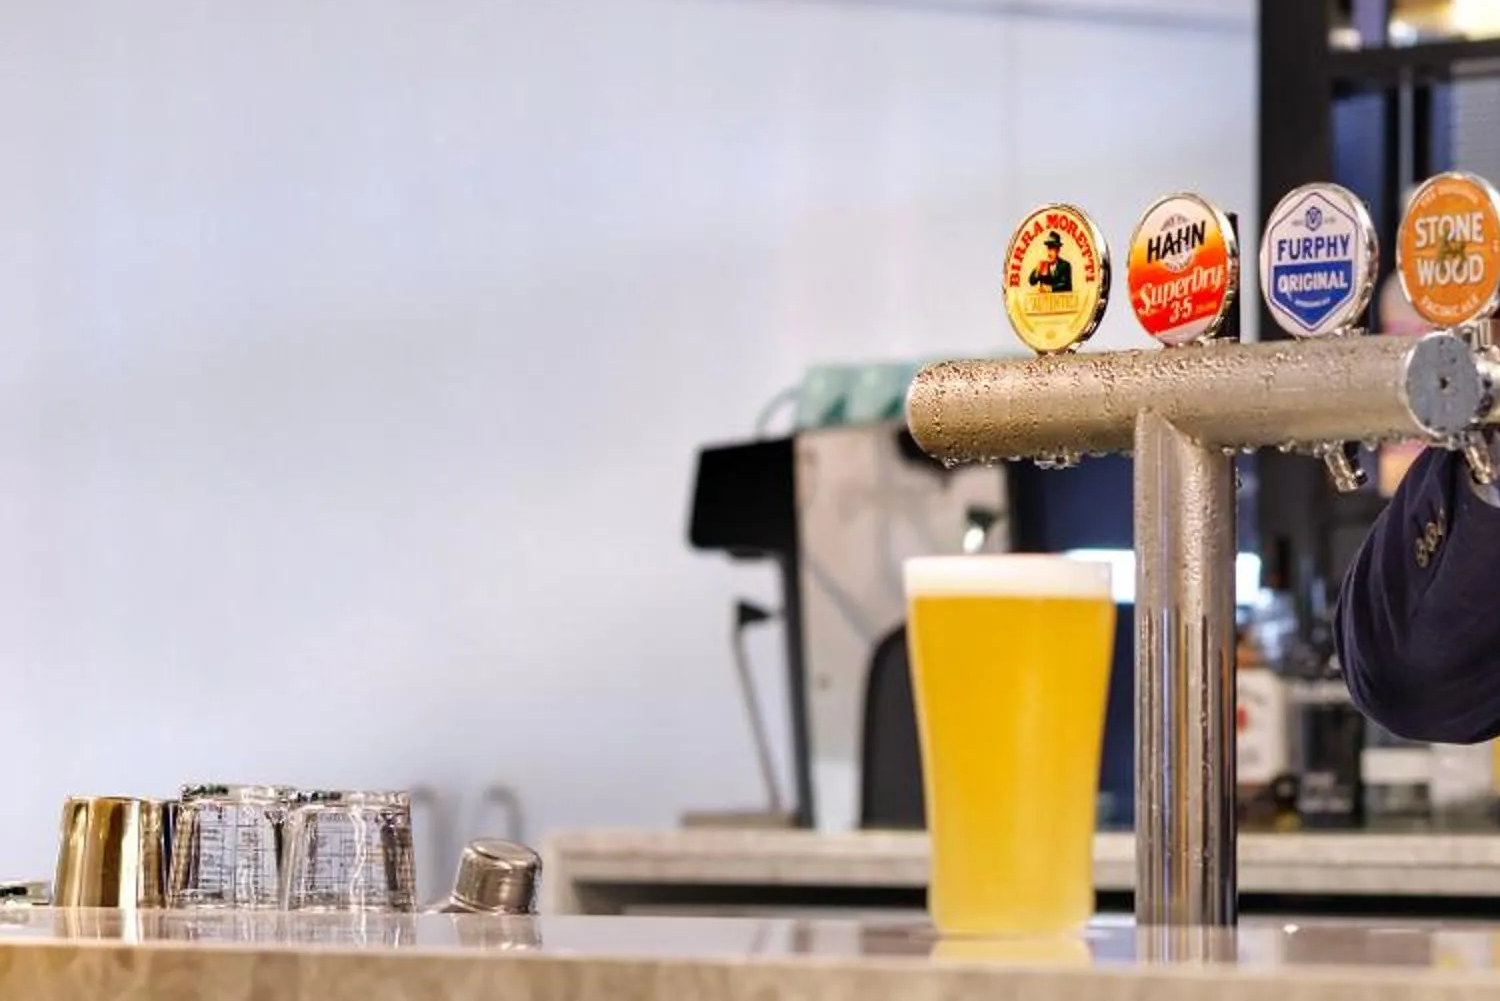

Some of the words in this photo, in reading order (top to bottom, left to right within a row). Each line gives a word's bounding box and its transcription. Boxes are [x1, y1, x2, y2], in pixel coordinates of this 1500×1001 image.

[1147, 220, 1206, 264] HAHN
[1415, 212, 1484, 248] STONE
[1009, 221, 1044, 287] BIRRA
[1046, 214, 1095, 283] MORETTI
[1277, 234, 1351, 262] FURPHY
[1278, 270, 1349, 298] ORIGINAL
[1416, 255, 1485, 287] WOOD
